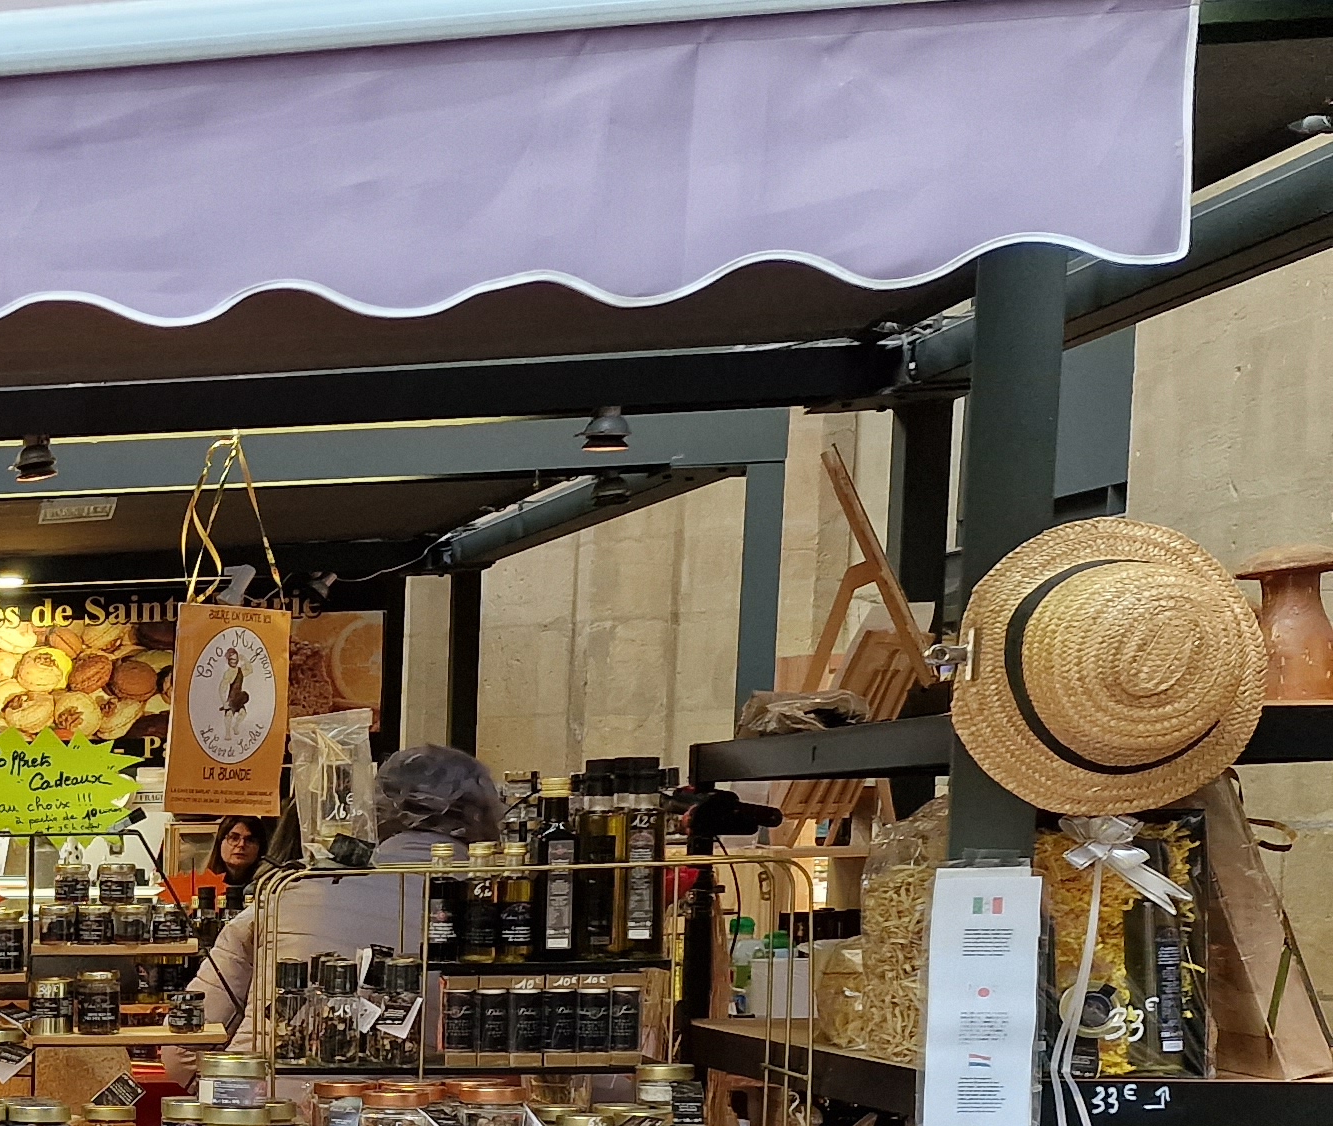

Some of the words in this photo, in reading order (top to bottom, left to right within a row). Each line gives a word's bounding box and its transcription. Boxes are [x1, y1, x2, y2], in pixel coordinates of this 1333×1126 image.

[32, 599, 73, 628] de
[242, 612, 262, 623] VENTE
[29, 771, 113, 791] Cadeaux
[203, 767, 215, 780] LA
[218, 767, 252, 781] BLONDE
[27, 796, 71, 811] choix
[1091, 1084, 1137, 1114] 33€
